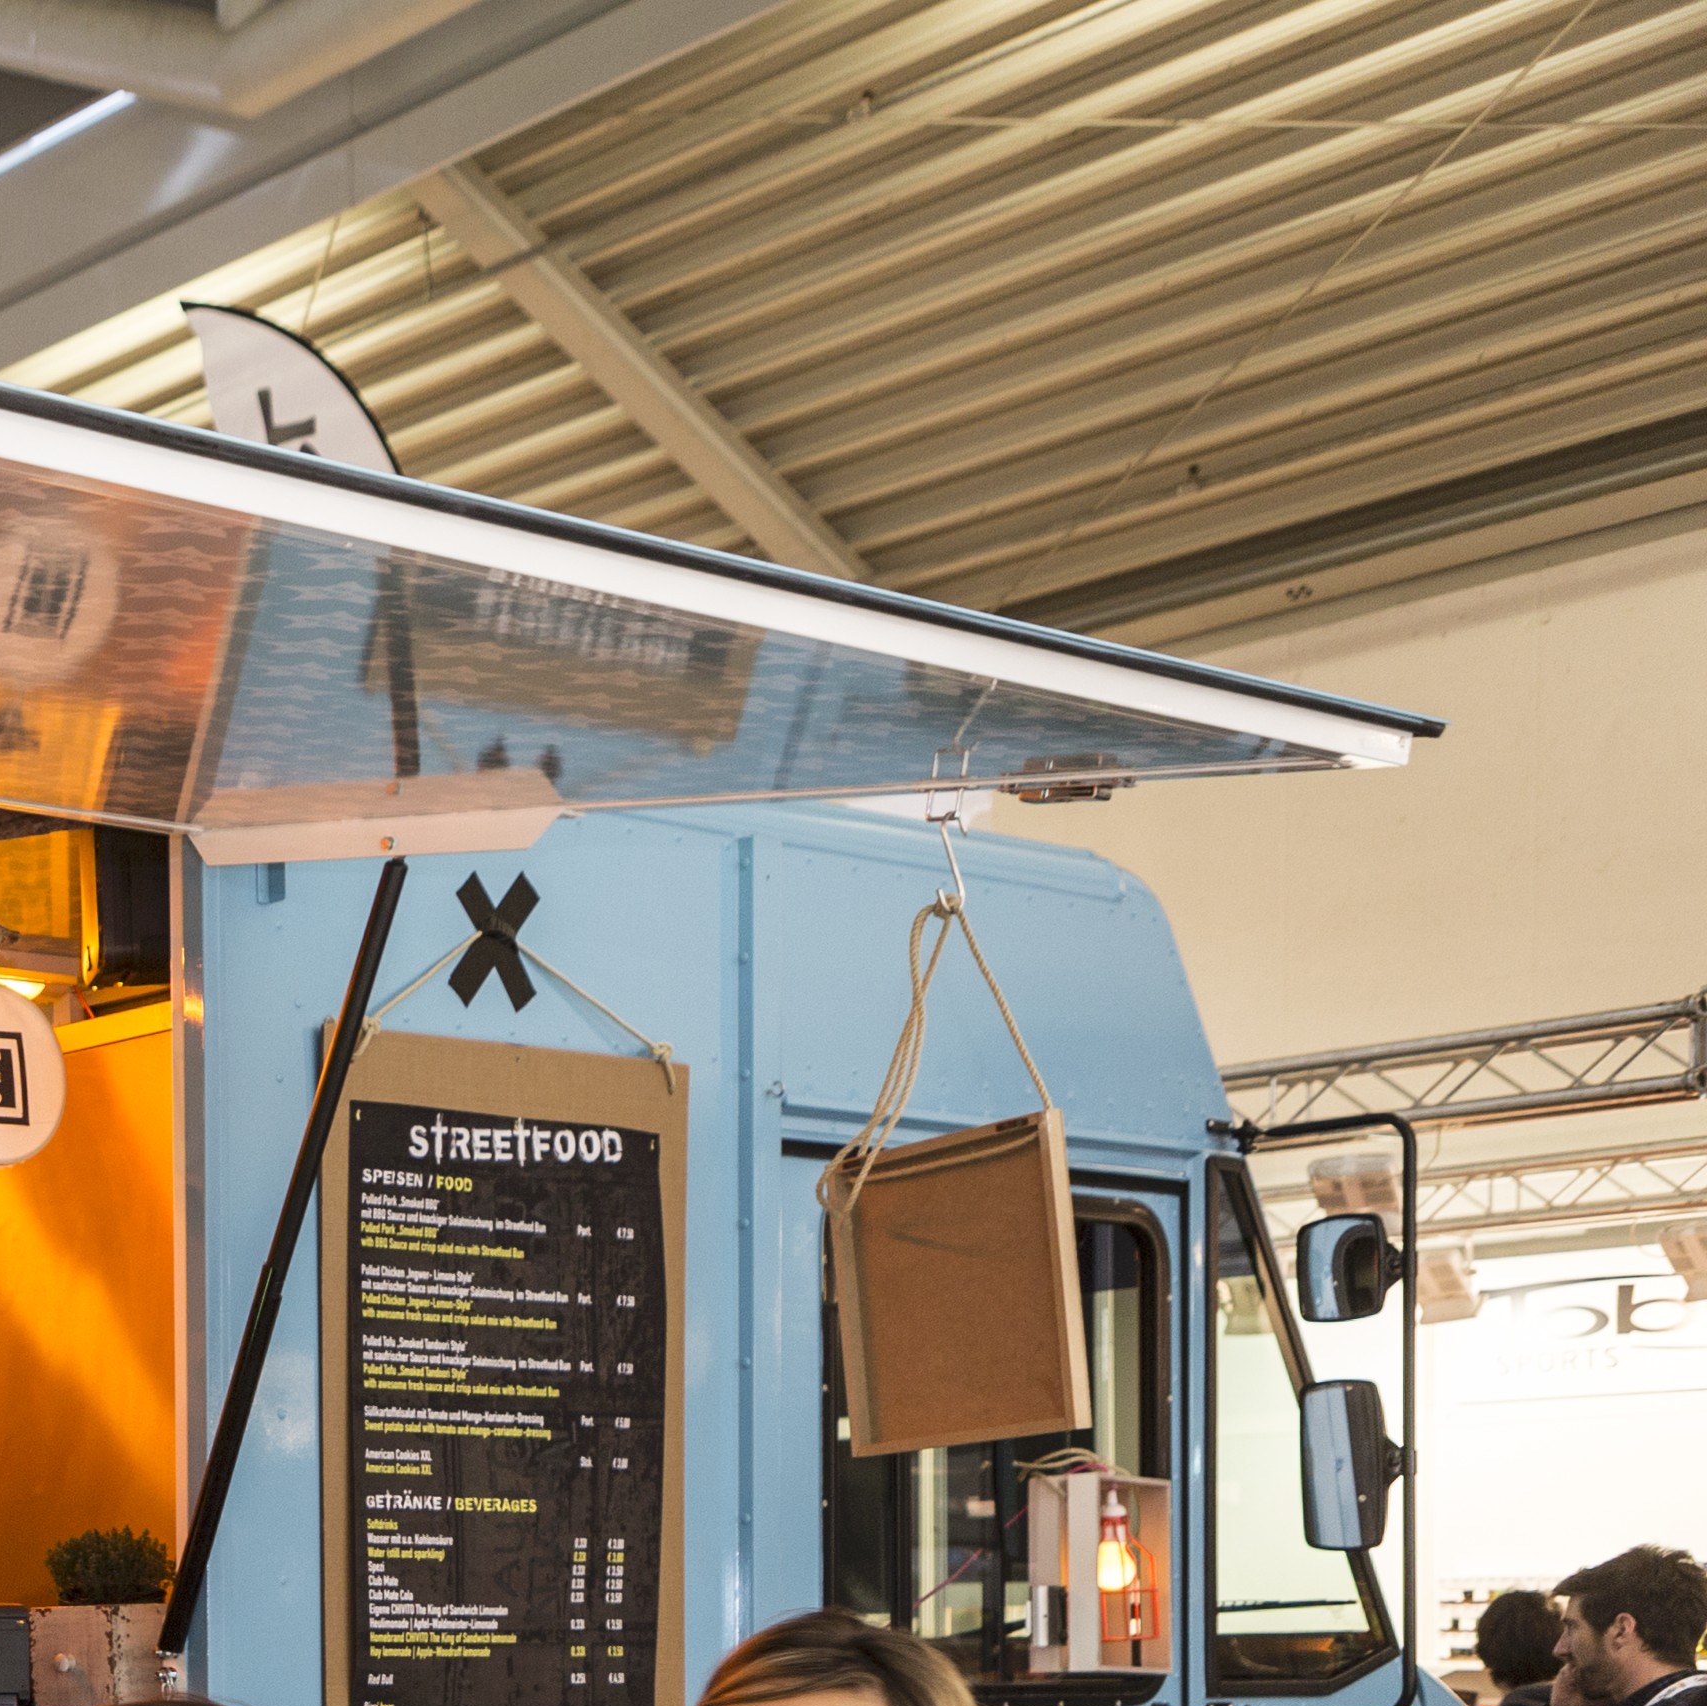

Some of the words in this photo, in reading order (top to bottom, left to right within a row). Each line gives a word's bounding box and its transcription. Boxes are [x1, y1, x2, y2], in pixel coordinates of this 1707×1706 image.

[408, 1112, 624, 1167] STREETFOOD
[361, 1168, 424, 1188] SPEISEN
[436, 1174, 473, 1193] FOOD
[366, 1489, 443, 1512] GETRÄNKE
[454, 1497, 538, 1513] BEVERAGES
